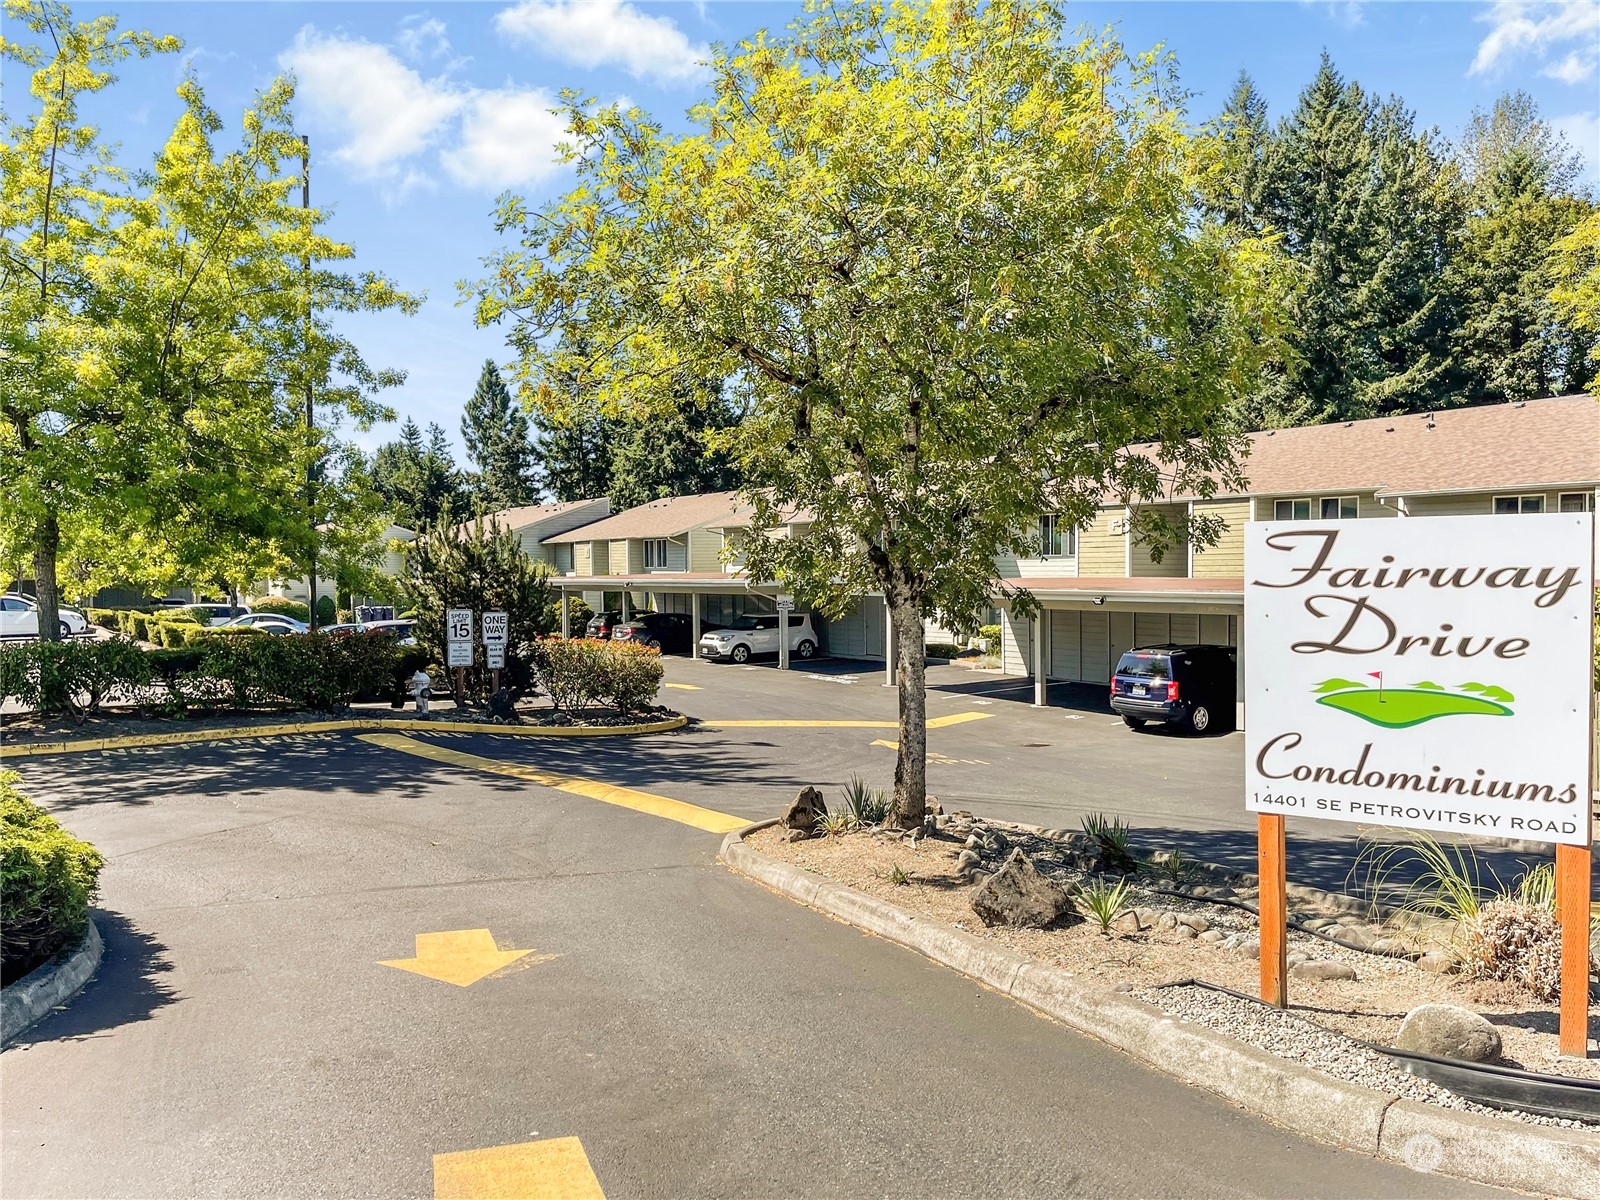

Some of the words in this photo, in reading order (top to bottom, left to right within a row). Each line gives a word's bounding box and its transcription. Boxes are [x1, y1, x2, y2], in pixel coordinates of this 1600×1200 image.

[1251, 529, 1583, 608] Fairway
[450, 624, 470, 638] 15
[484, 616, 506, 625] ONE
[485, 626, 506, 634] WAY
[1290, 594, 1531, 659] Drive
[178, 732, 341, 750] PARKING
[1256, 732, 1577, 804] Condominiums
[1253, 792, 1307, 808] 14401
[1316, 799, 1342, 812] SE
[1350, 802, 1501, 828] PETROVITSKY
[1511, 817, 1577, 835] ROAD
